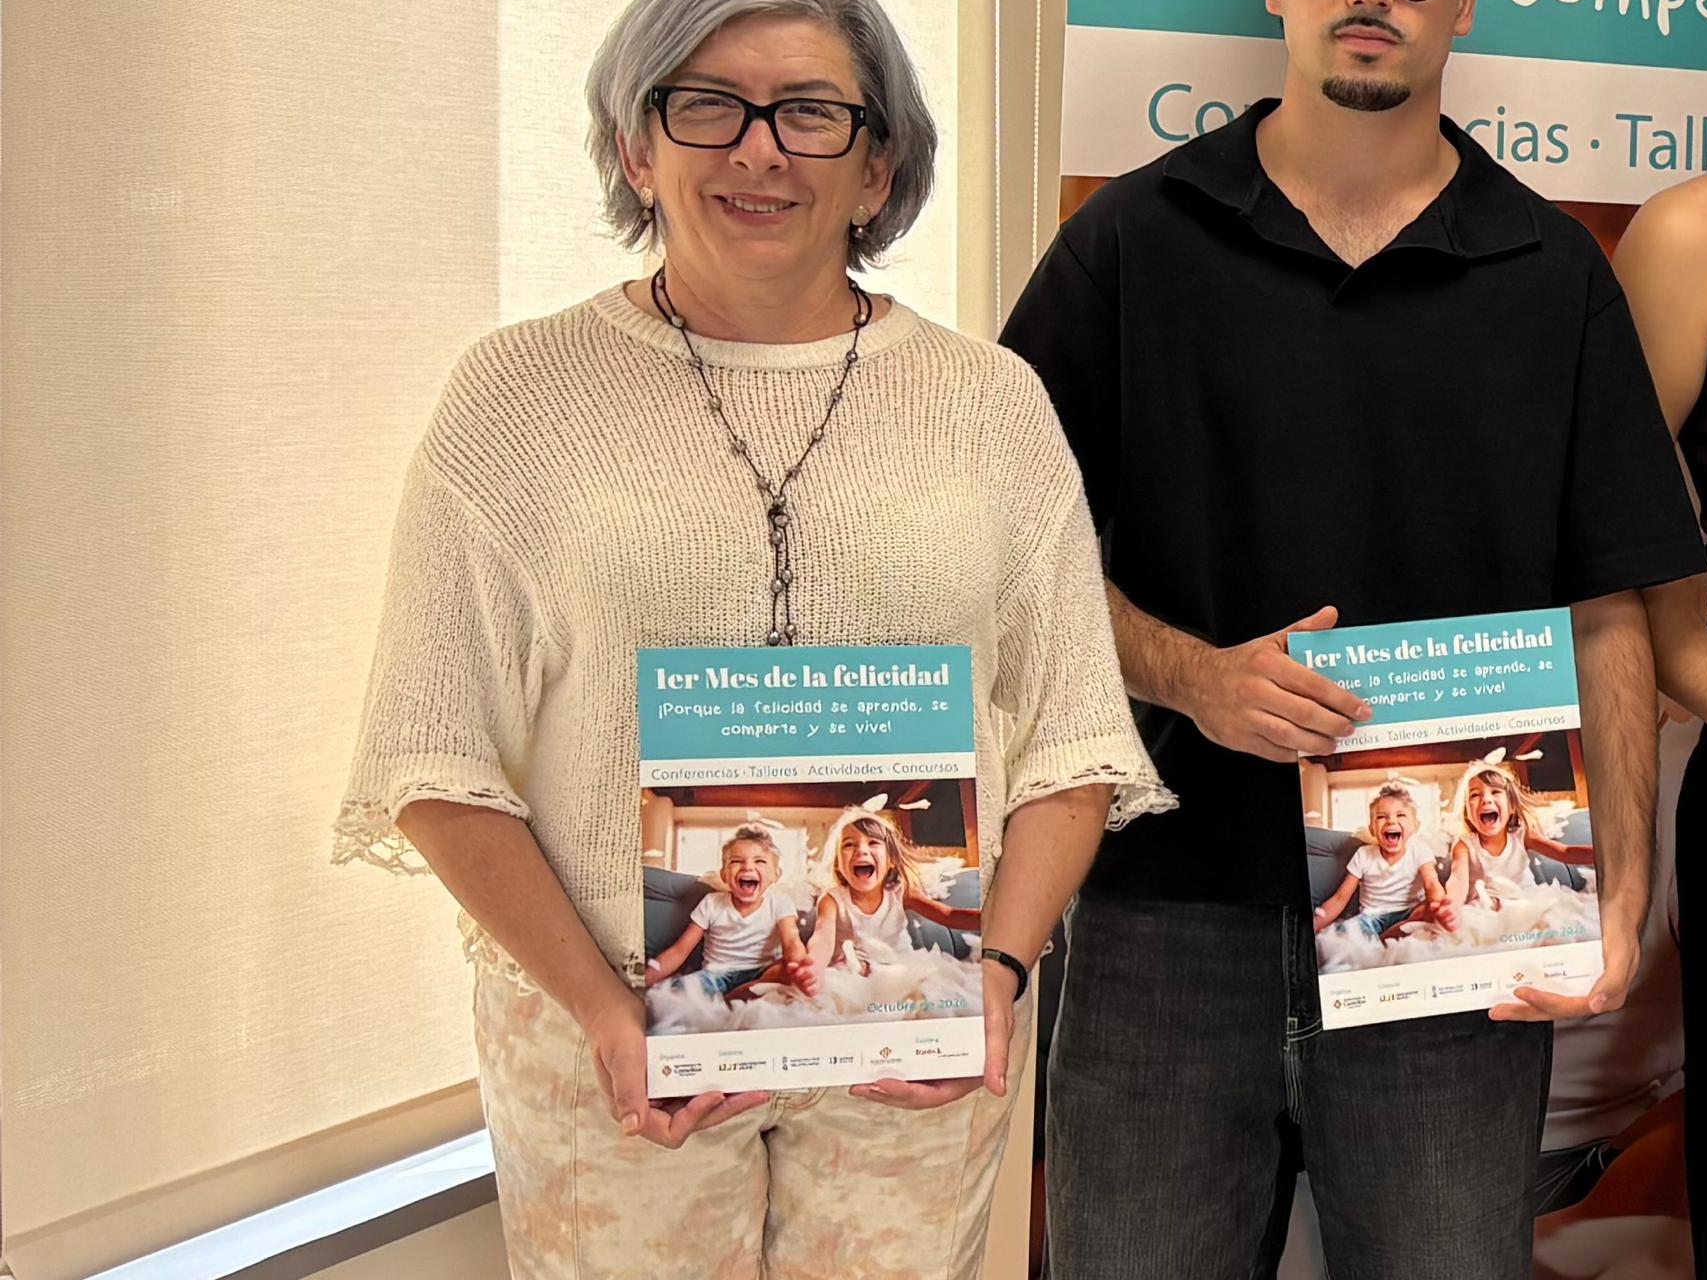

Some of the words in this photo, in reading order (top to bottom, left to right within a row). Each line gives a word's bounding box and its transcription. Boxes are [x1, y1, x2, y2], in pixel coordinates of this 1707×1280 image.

[1345, 644, 1391, 665] Mes
[1394, 639, 1423, 661] de
[1426, 637, 1449, 658] la
[1453, 625, 1553, 655] felicidad
[705, 667, 759, 689] Mes
[763, 665, 797, 688] de
[802, 664, 829, 688] la
[833, 663, 949, 688] felicidad
